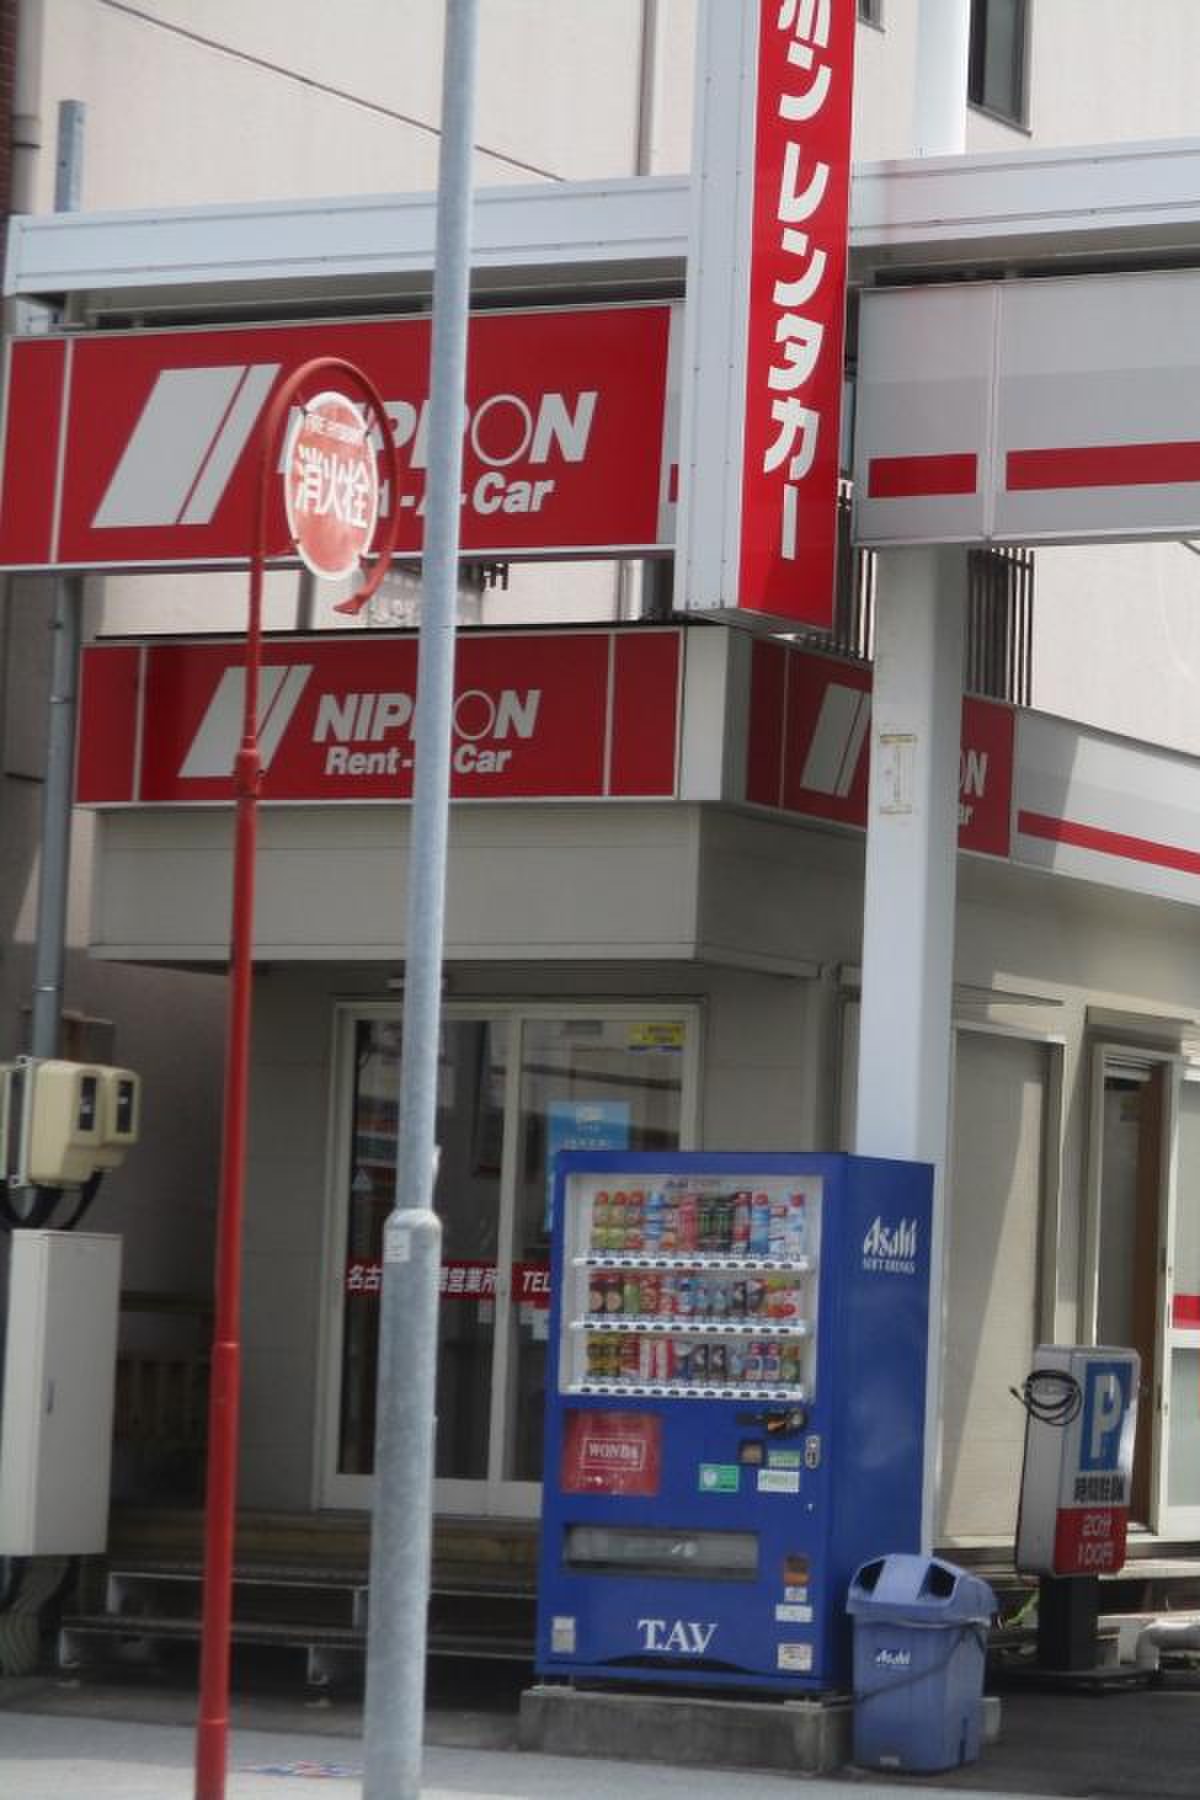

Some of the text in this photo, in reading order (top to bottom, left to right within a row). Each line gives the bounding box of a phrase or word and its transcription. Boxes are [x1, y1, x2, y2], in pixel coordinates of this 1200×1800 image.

[294, 444, 370, 528] 消火栓
[863, 1215, 917, 1258] Asahi
[1090, 1375, 1122, 1459] P
